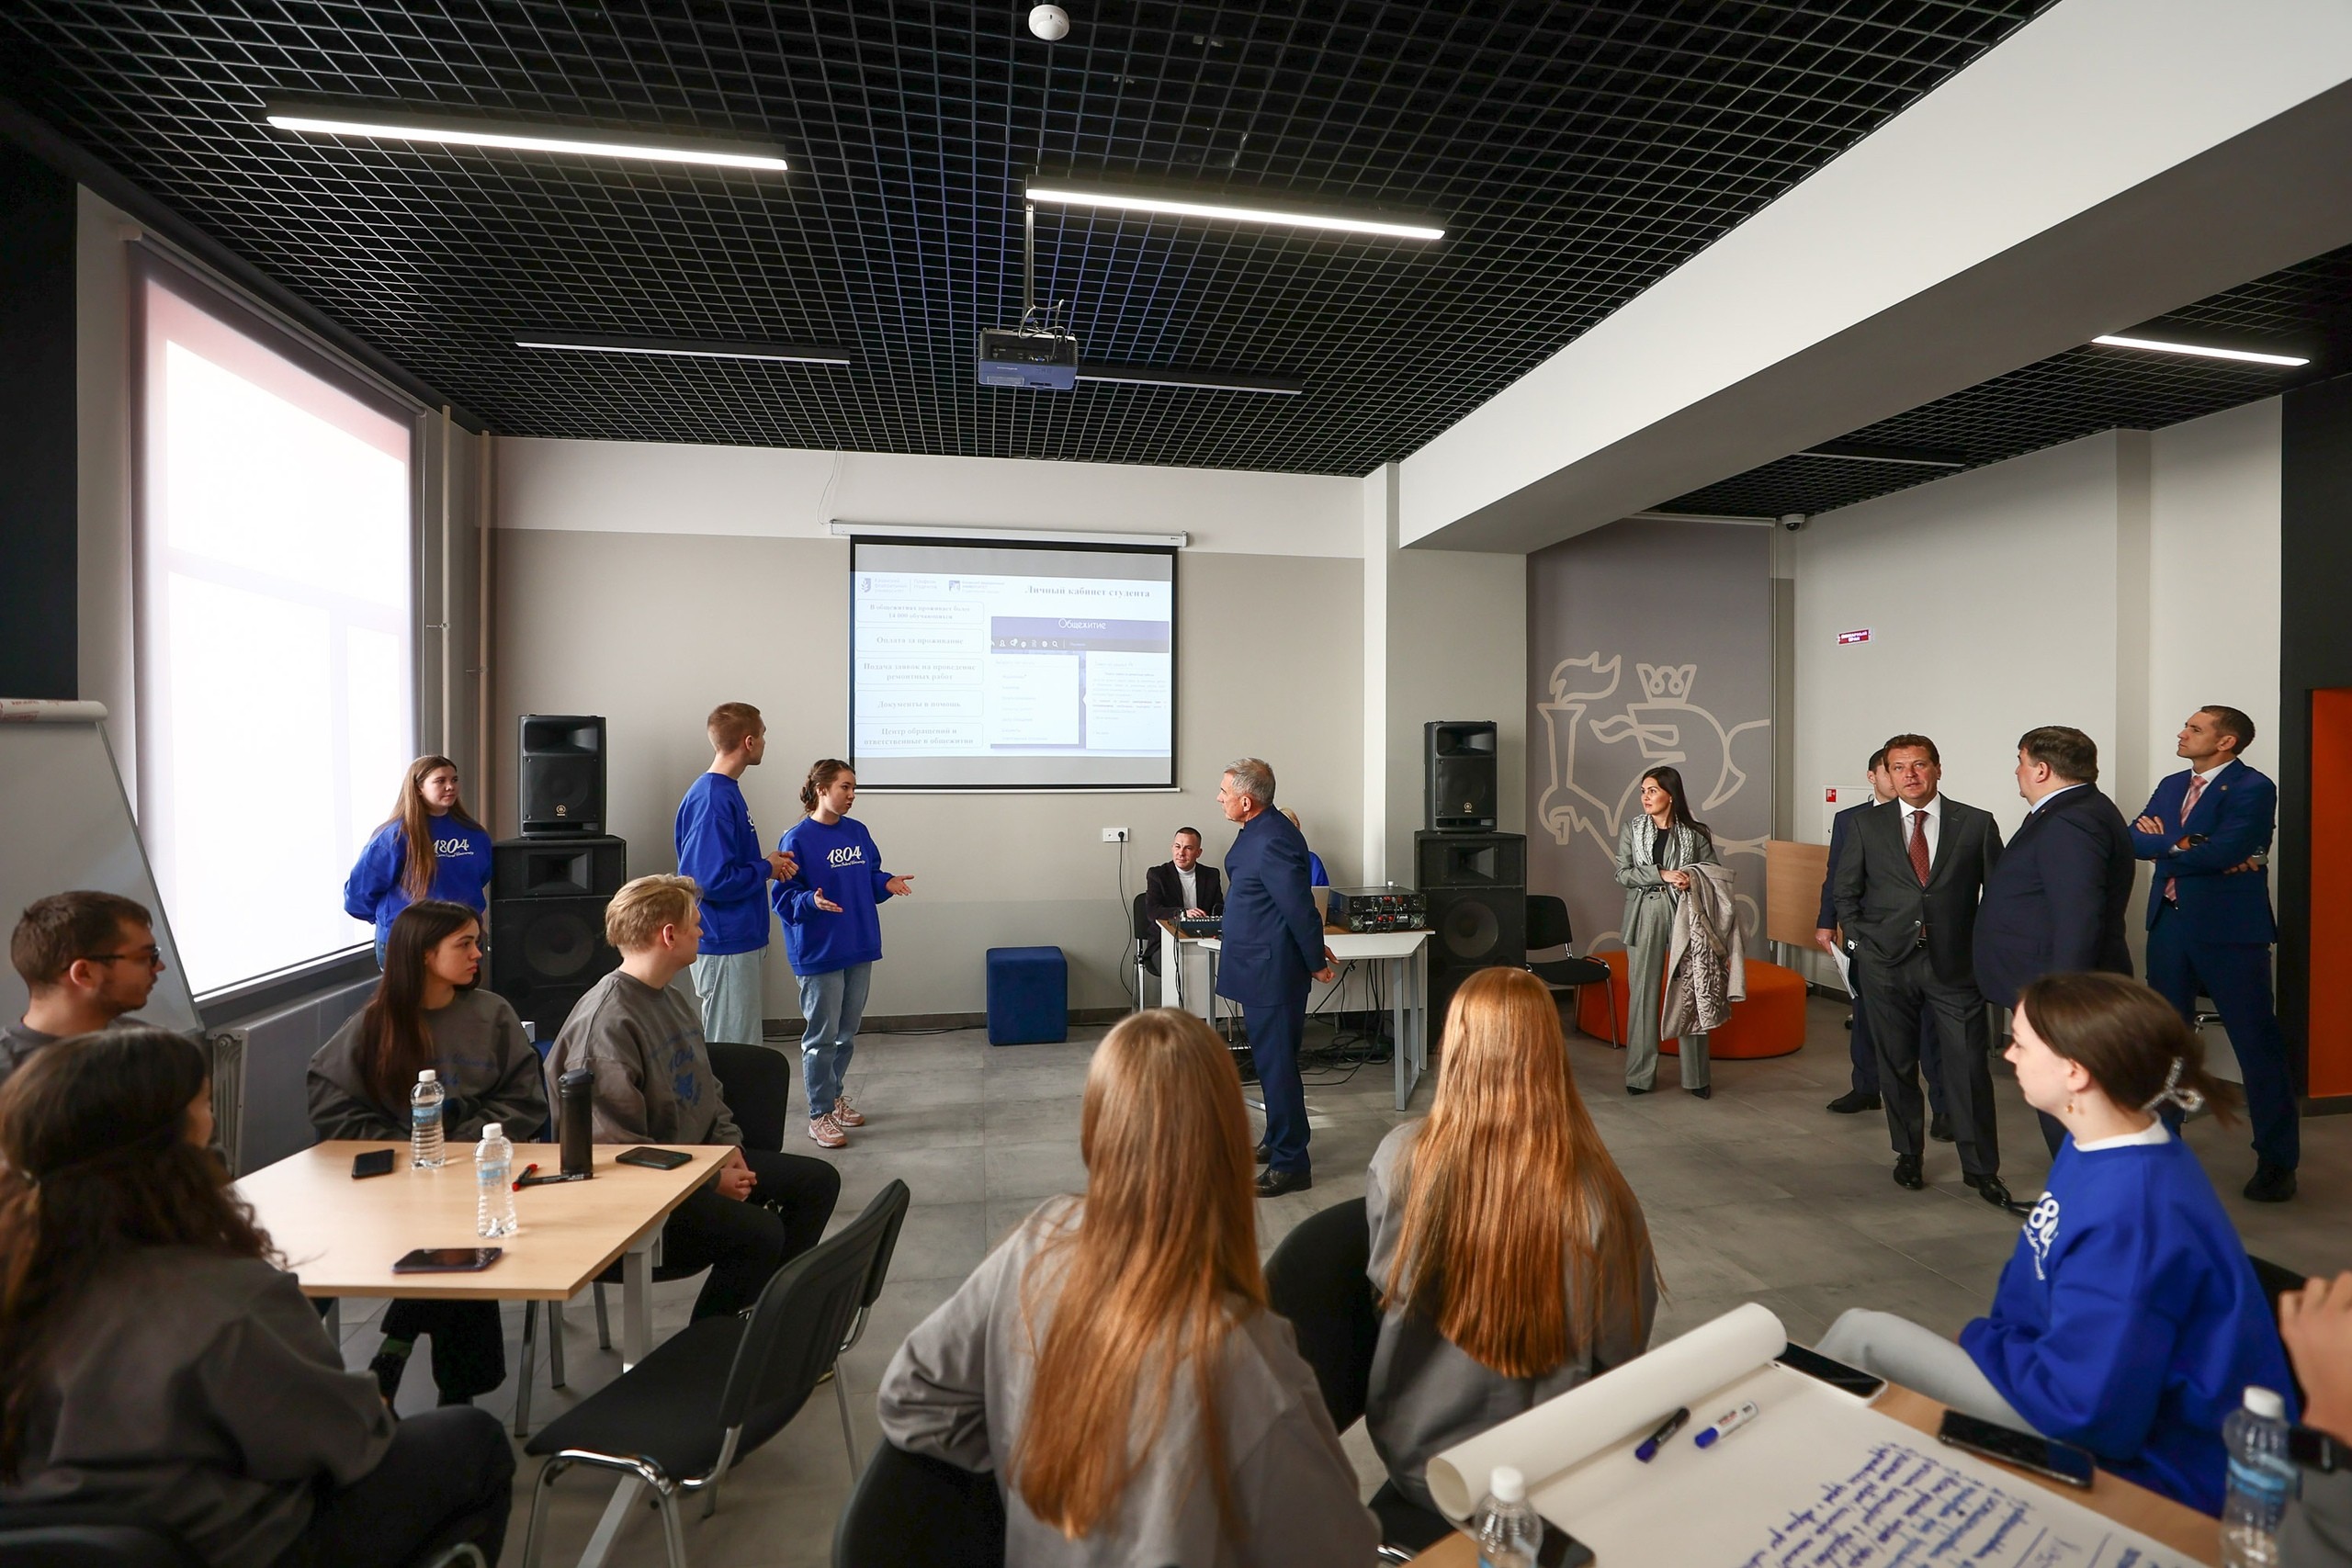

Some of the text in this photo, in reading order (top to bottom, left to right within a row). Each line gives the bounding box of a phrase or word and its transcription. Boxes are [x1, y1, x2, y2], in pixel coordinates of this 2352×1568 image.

[1025, 585, 1150, 598] Личный кабинет студента
[1058, 618, 1106, 630] Общежитие
[876, 636, 906, 644] Оплата
[918, 637, 964, 646] проживание
[864, 662, 892, 671] Подача
[933, 663, 977, 672] проведение
[932, 673, 953, 682] работ
[877, 701, 922, 709] Документы
[881, 728, 906, 736] Центр
[907, 727, 951, 736] обращений
[434, 838, 469, 854] 1804
[827, 845, 862, 864] 1804
